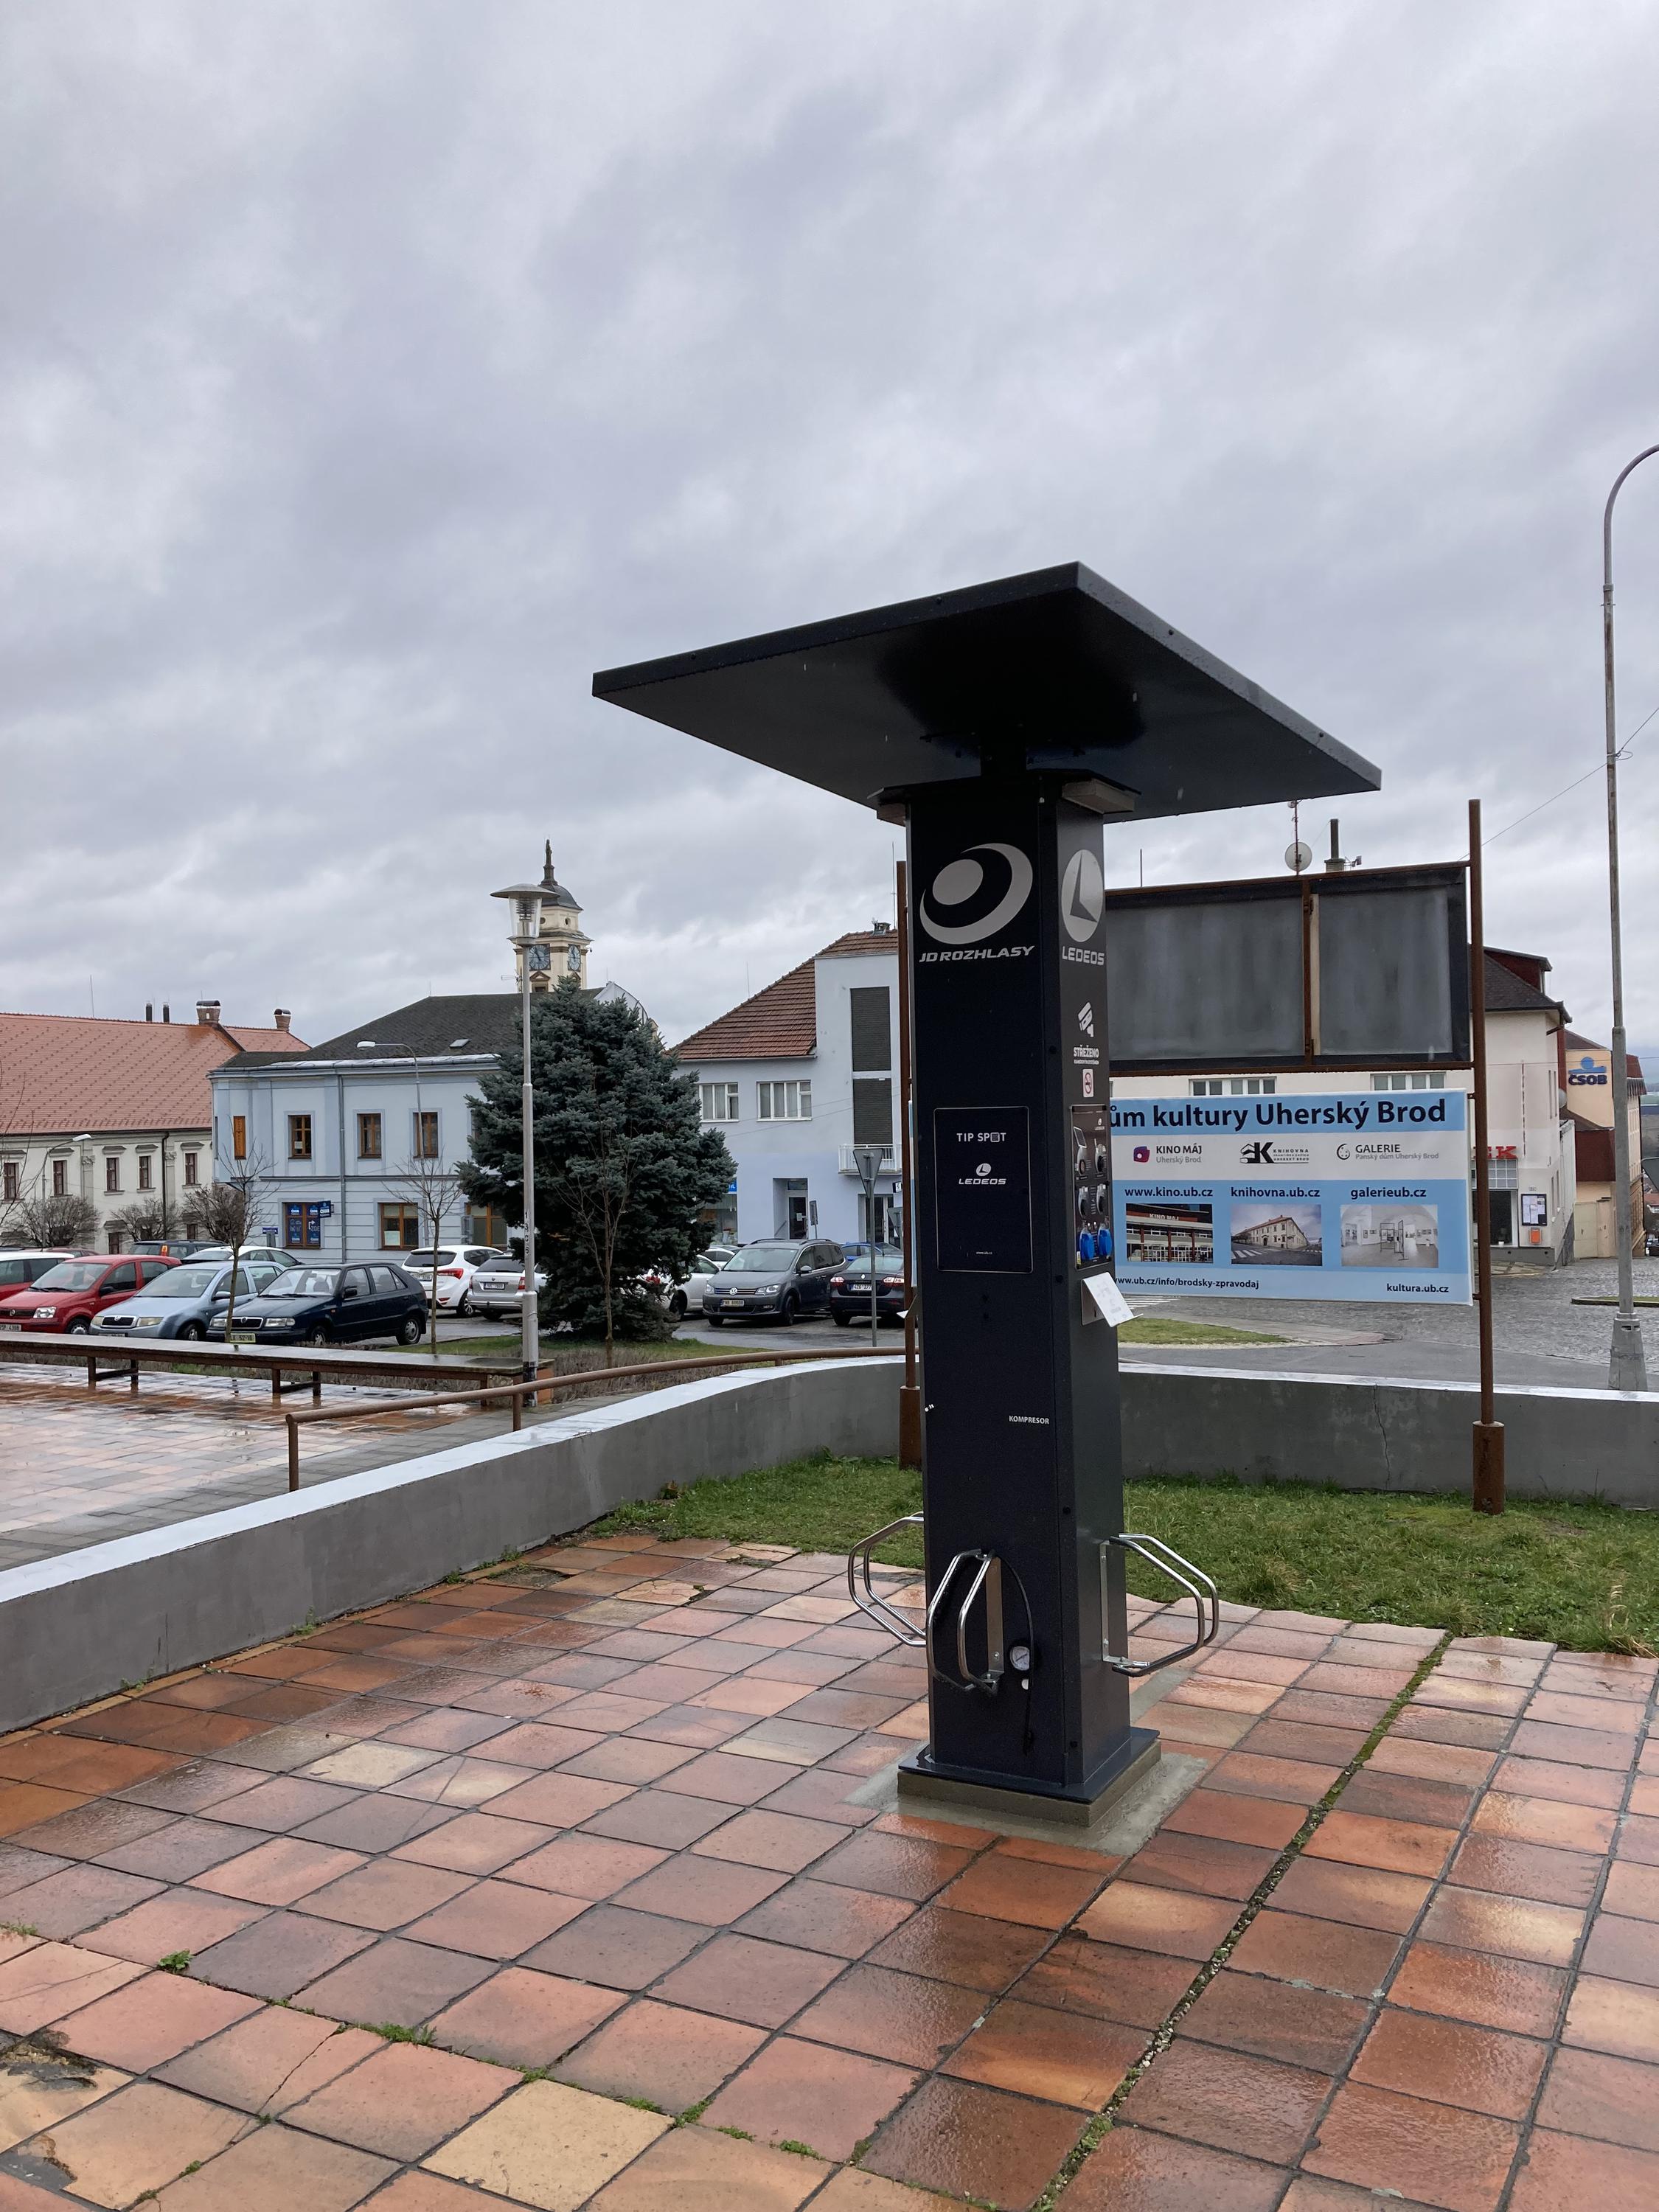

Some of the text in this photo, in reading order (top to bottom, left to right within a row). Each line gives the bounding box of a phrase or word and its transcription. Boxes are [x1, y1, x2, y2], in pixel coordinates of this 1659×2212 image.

[919, 945, 1035, 962] JD ROZHLASY
[1062, 946, 1105, 965] LEDEOS
[1074, 1045, 1099, 1058] STŘEŽENO
[1568, 1074, 1608, 1085] ČSOB
[1110, 1099, 1446, 1132] ům kultury Uherský Brod
[956, 1132, 1006, 1143] TIP SPOT
[1156, 1143, 1203, 1155] KINO MÁJ
[1355, 1144, 1402, 1153] GALERIE
[1156, 1156, 1183, 1164] Uherský
[1124, 1187, 1214, 1197] www.kino.ub.cz
[1231, 1187, 1321, 1197] knihovna.ub.cz
[1350, 1187, 1427, 1200] galerieub.cz
[1386, 1284, 1449, 1293] kultura.ub.cz
[1009, 1415, 1049, 1425] KOMPRESOR
